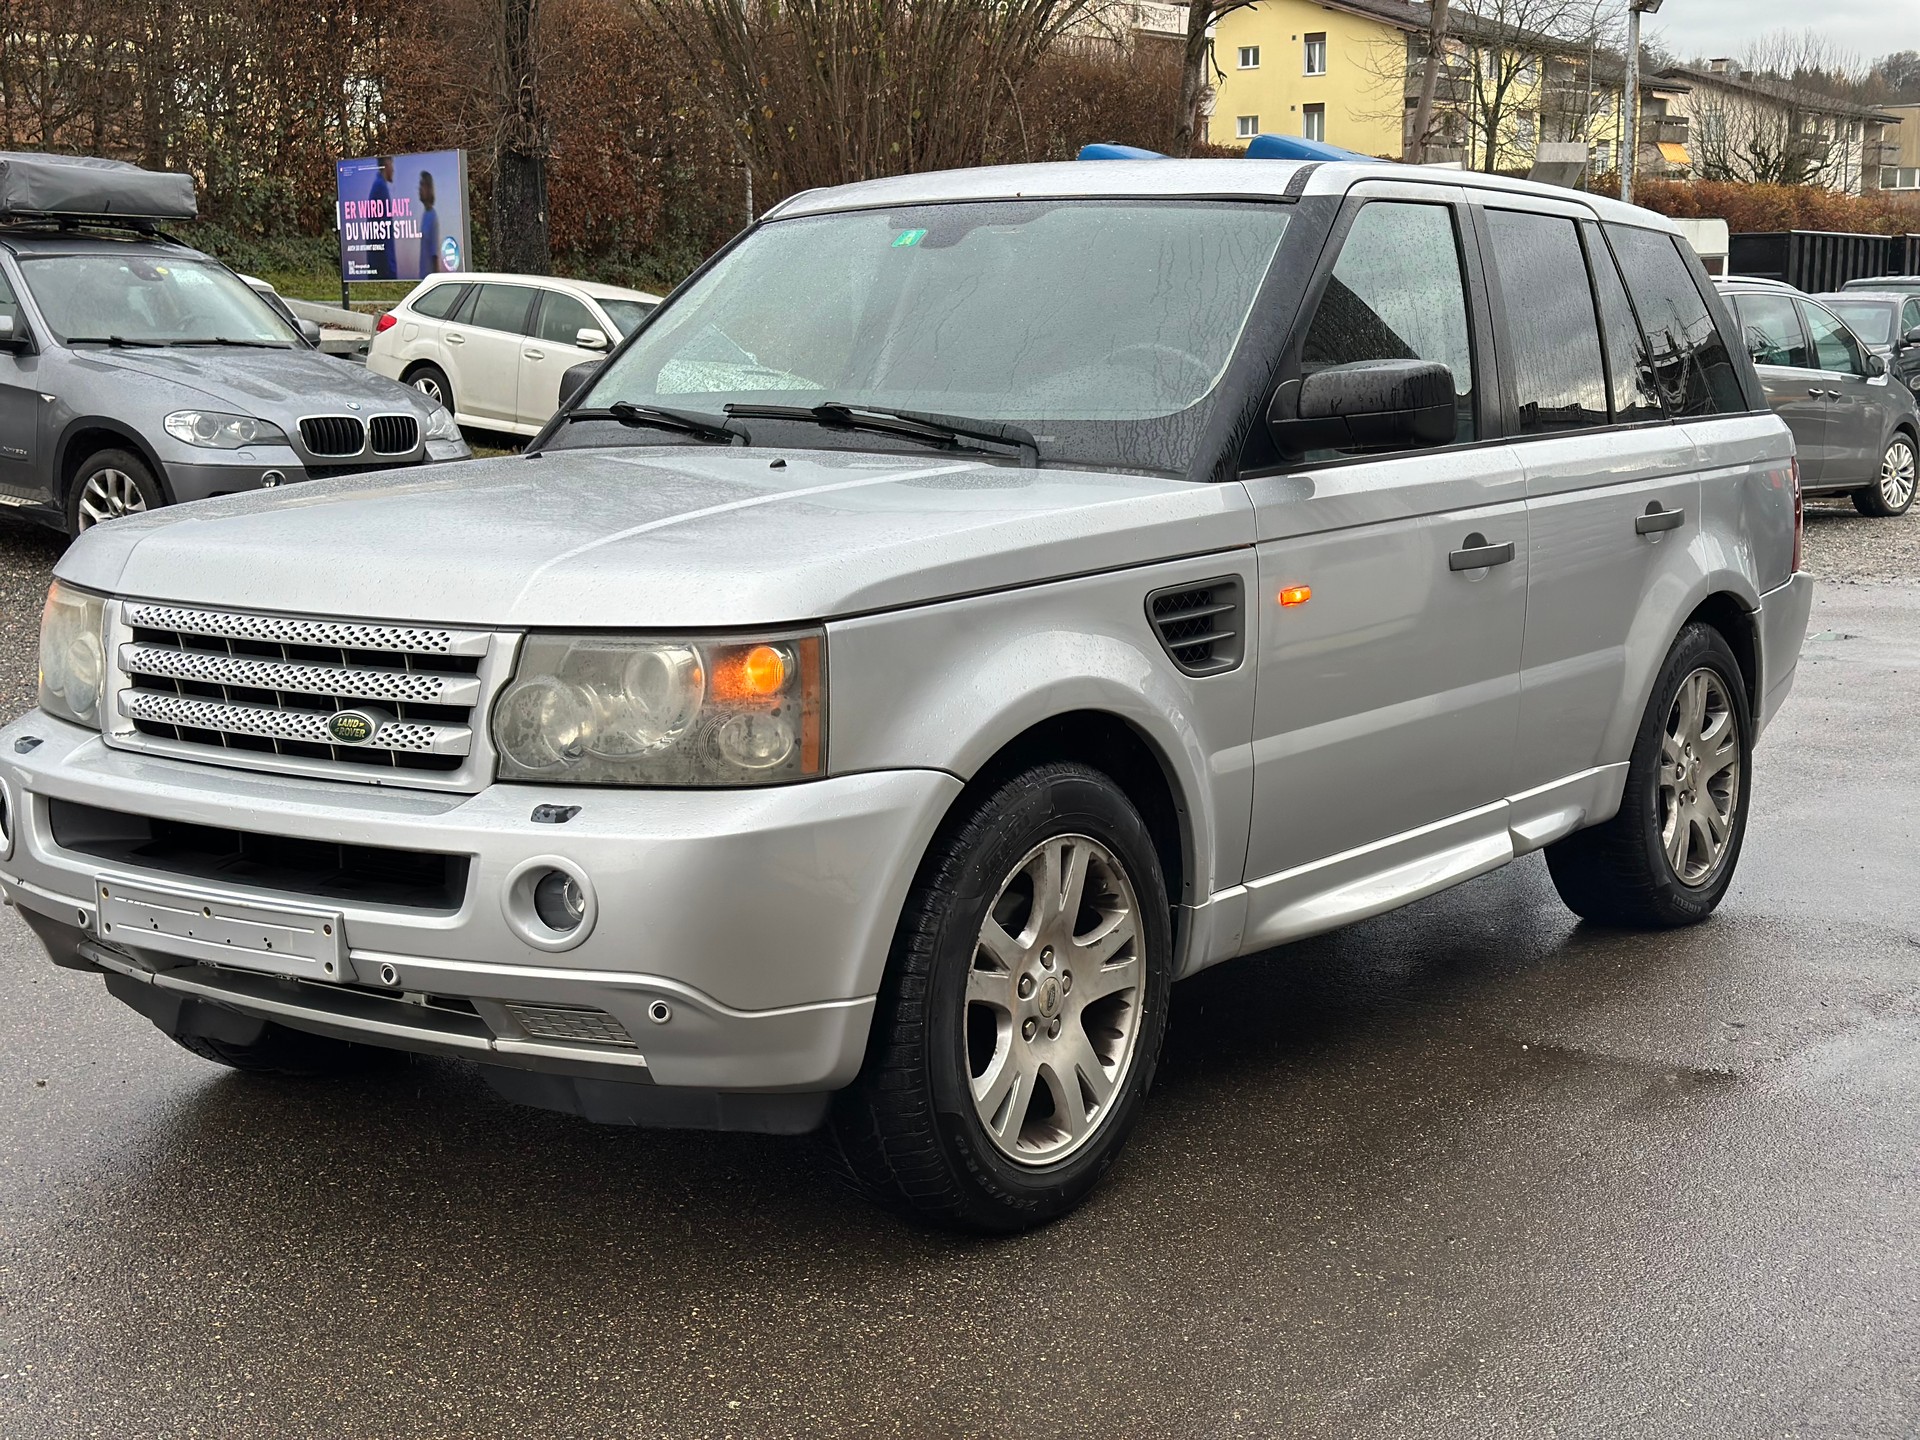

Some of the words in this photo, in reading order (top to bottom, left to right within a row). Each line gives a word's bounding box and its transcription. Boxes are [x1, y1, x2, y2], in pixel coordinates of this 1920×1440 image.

[344, 201, 356, 219] ER
[358, 199, 384, 218] WIRD
[386, 198, 412, 217] LAUT.
[345, 222, 359, 240] DU
[360, 220, 391, 240] WIRST
[393, 219, 423, 239] STILL.
[337, 718, 359, 728] LAND
[338, 727, 366, 738] ROVER
